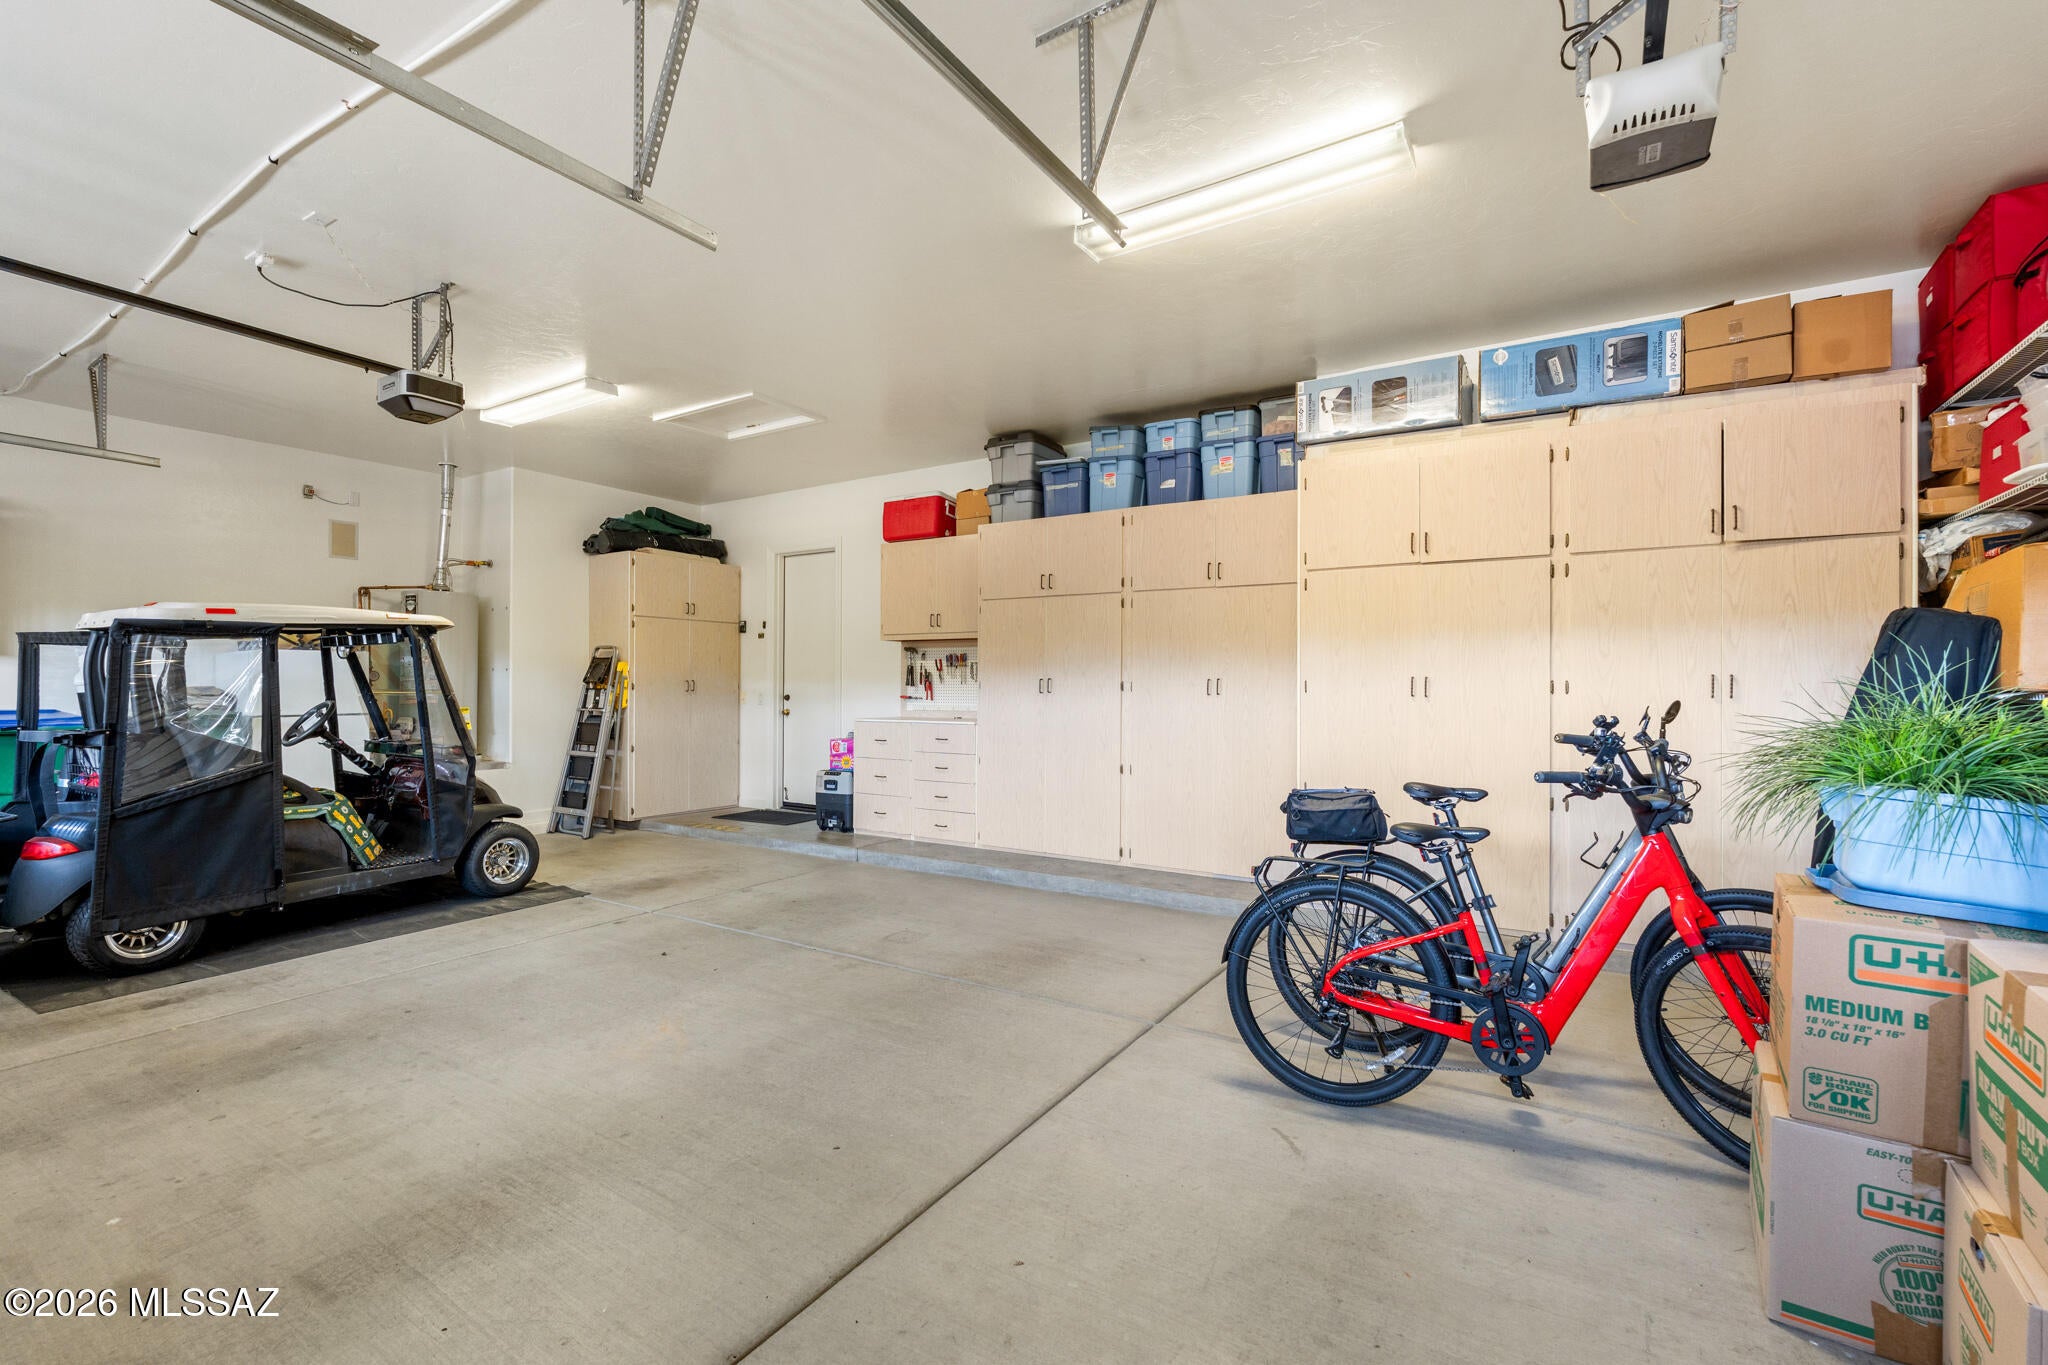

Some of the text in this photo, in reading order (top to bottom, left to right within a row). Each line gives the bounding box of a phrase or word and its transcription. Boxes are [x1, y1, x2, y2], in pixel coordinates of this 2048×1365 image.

[1863, 944, 1961, 978] U-H
[1804, 994, 1930, 1031] MEDIUM B
[1805, 1015, 1819, 1025] 18
[1804, 1026, 1873, 1047] 3.0 CU FT
[1825, 1075, 1873, 1090] U-HAUL
[1825, 1082, 1873, 1096] BOXES
[1807, 1101, 1872, 1120] FOR SHIPPING
[1830, 1091, 1871, 1112] OK
[1866, 1147, 1912, 1165] EASY-TO
[1916, 1244, 1938, 1256] TAKE
